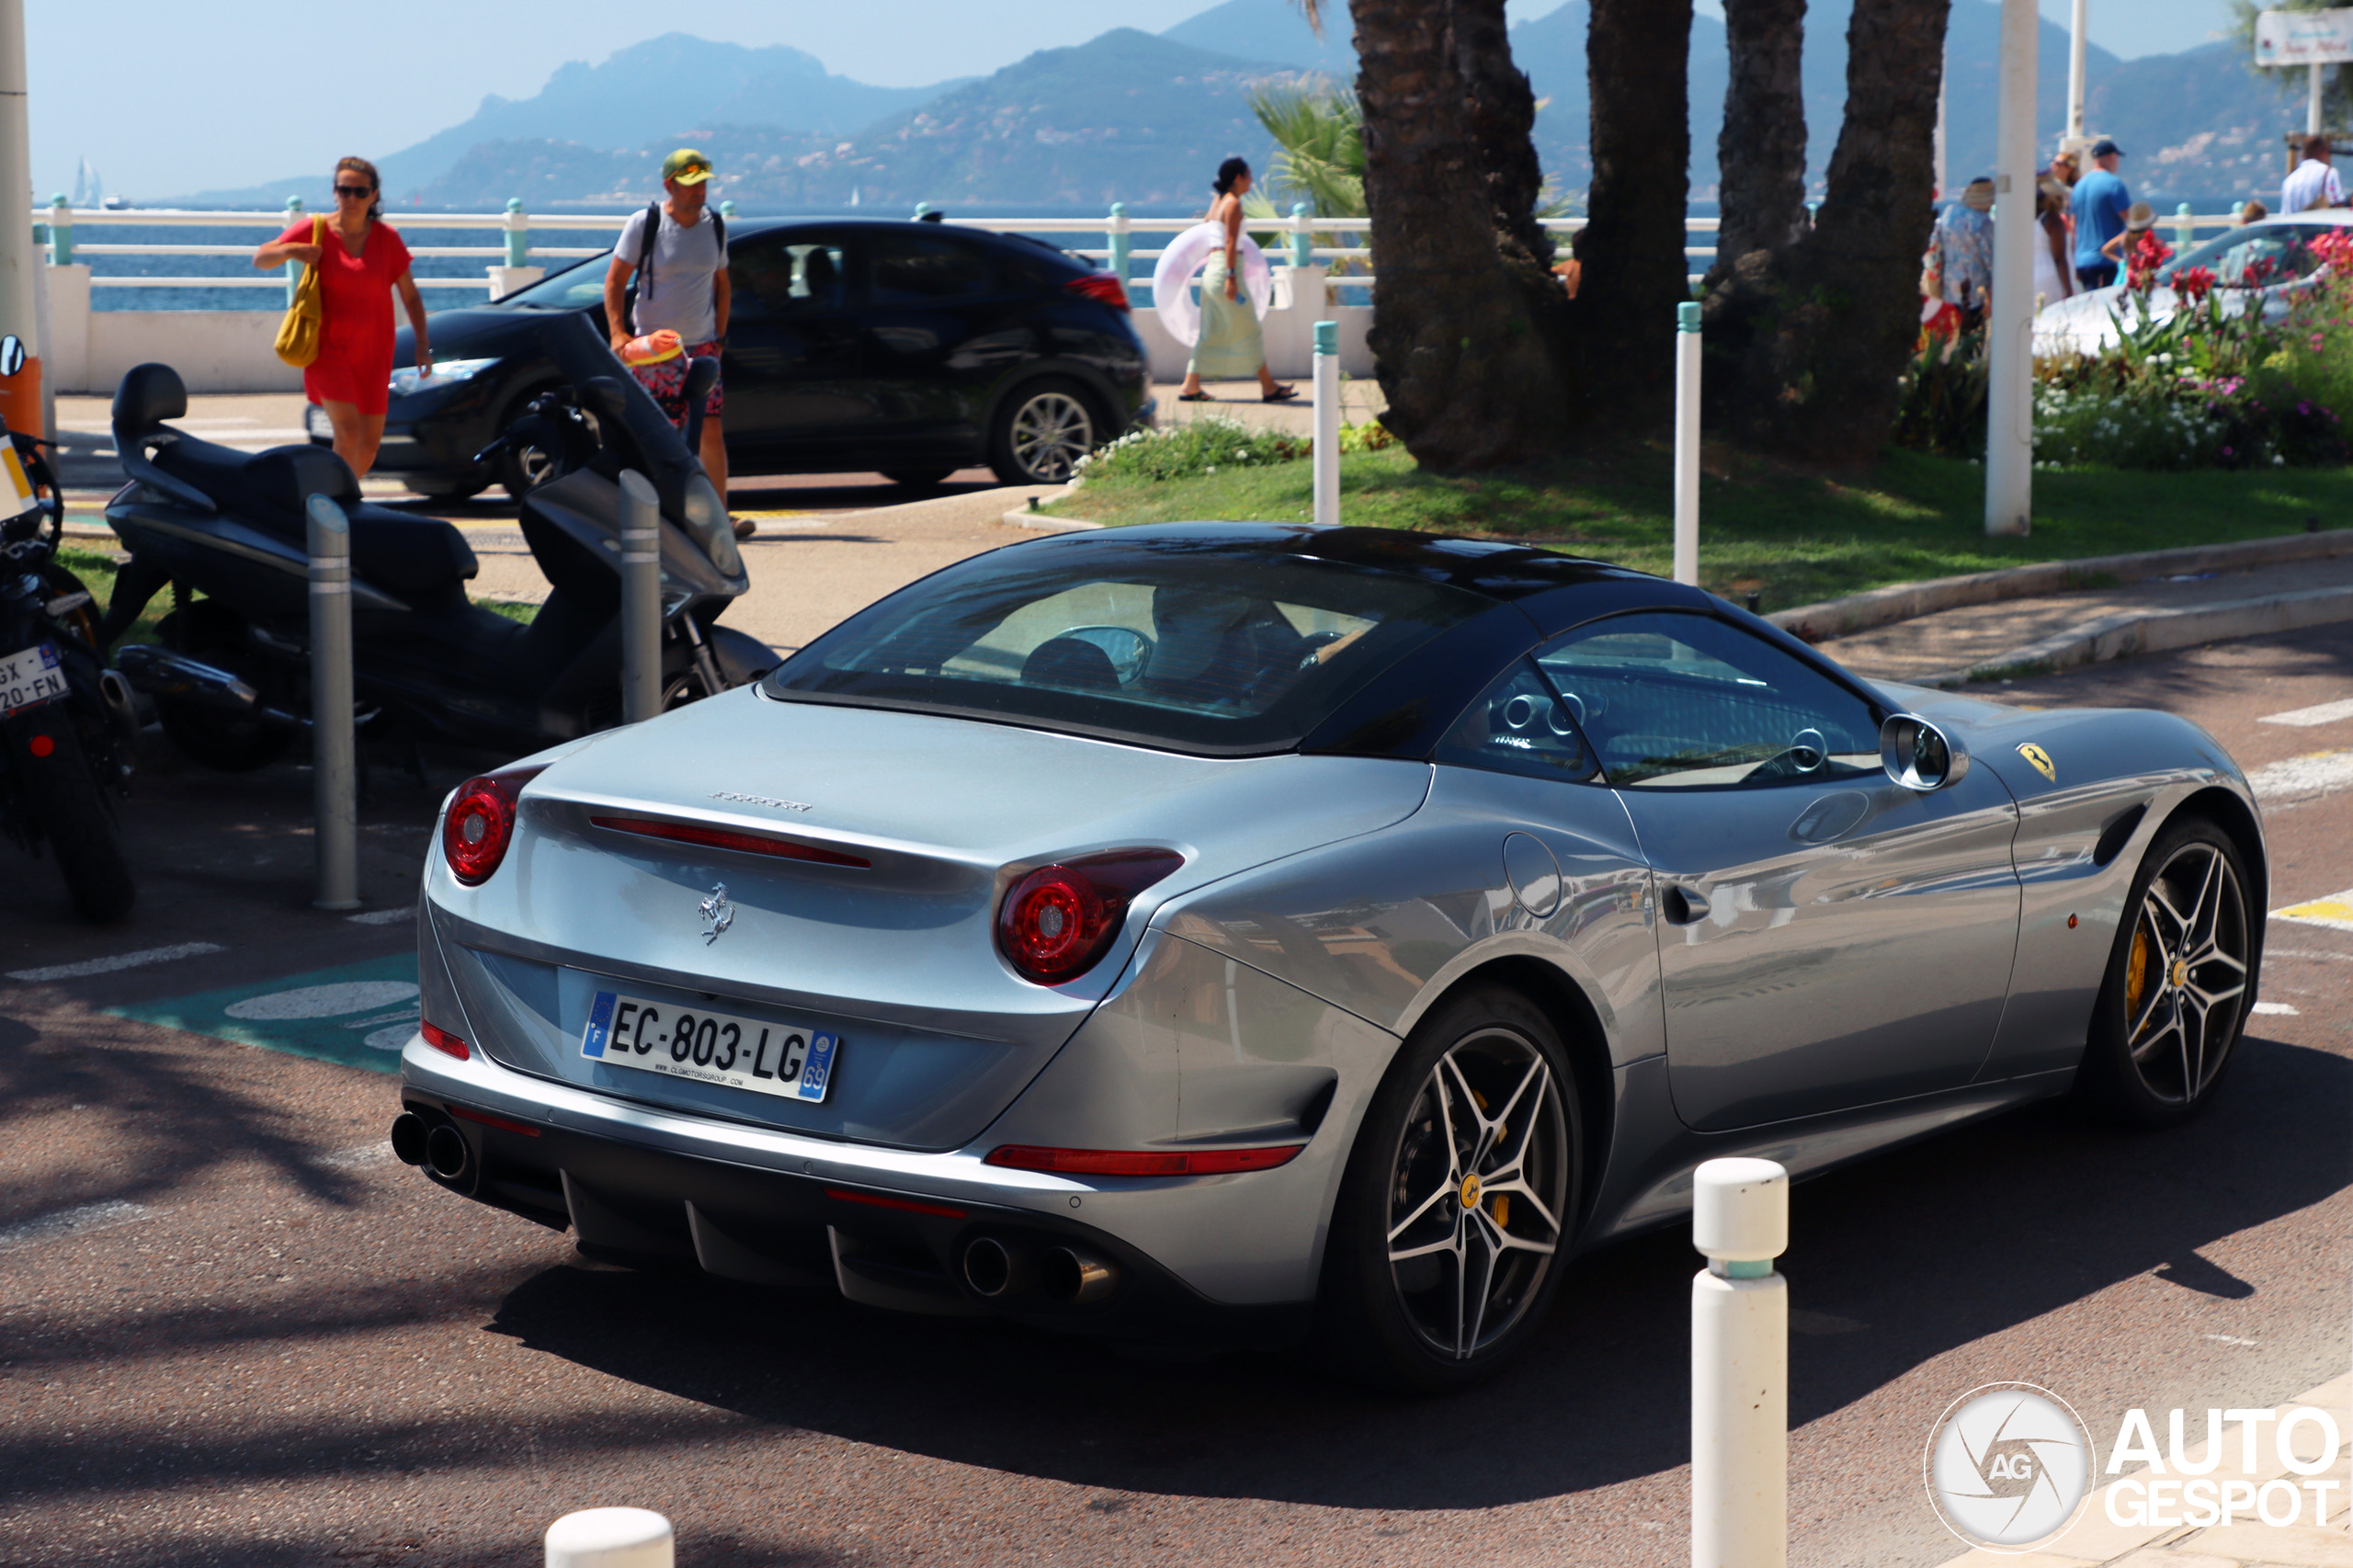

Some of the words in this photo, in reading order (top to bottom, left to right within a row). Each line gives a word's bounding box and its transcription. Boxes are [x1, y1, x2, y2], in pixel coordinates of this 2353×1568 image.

[592, 1029, 602, 1043] F
[610, 1002, 805, 1083] EC-803-LG
[802, 1066, 825, 1090] 69
